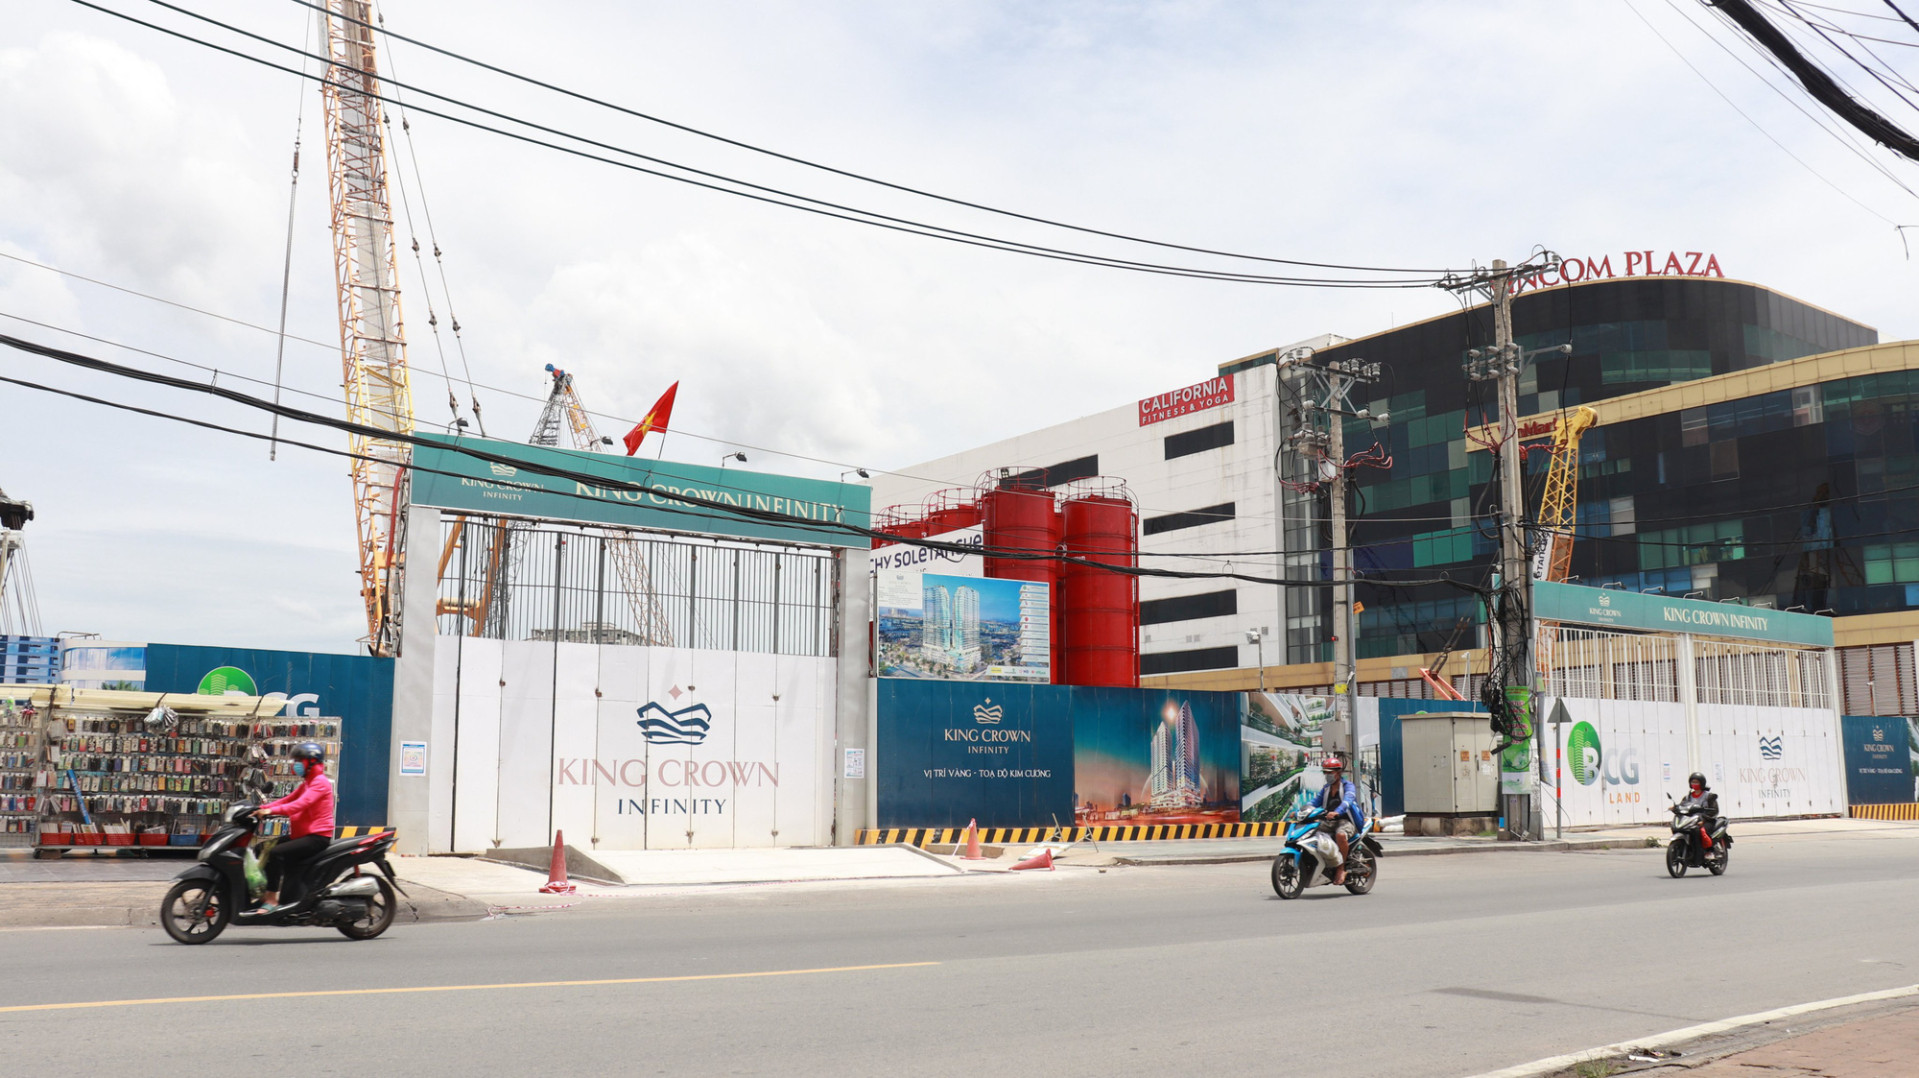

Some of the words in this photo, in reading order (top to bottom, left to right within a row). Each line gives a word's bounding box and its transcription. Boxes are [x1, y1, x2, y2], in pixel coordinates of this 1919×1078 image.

[1491, 255, 1616, 294] INCOM
[1624, 250, 1725, 278] PLAZA
[1141, 378, 1228, 414] CALIFORNIA
[1142, 405, 1185, 425] FITNESS
[1189, 403, 1196, 411] &
[1199, 394, 1229, 408] YOGA
[461, 477, 494, 489] KING
[496, 479, 545, 496] CROWN
[483, 490, 523, 501] INFINITY
[575, 480, 643, 502] KING
[746, 494, 845, 523] INFINITY
[1663, 606, 1691, 624] KING
[1692, 609, 1729, 627] CROWN
[1730, 613, 1768, 631] INFINITY
[944, 728, 979, 742] KING
[981, 729, 1031, 743] CROWN
[968, 745, 1010, 755] INFINITY
[558, 757, 647, 788] KING
[657, 759, 780, 788] CROWN
[948, 767, 972, 778] VÀNG
[1009, 769, 1023, 778] KIM
[1582, 746, 1640, 786] BCG
[1739, 767, 1766, 783] KING
[1609, 792, 1641, 804] LAND
[1758, 789, 1792, 799] INFINITY
[617, 798, 727, 815] INFINITY
